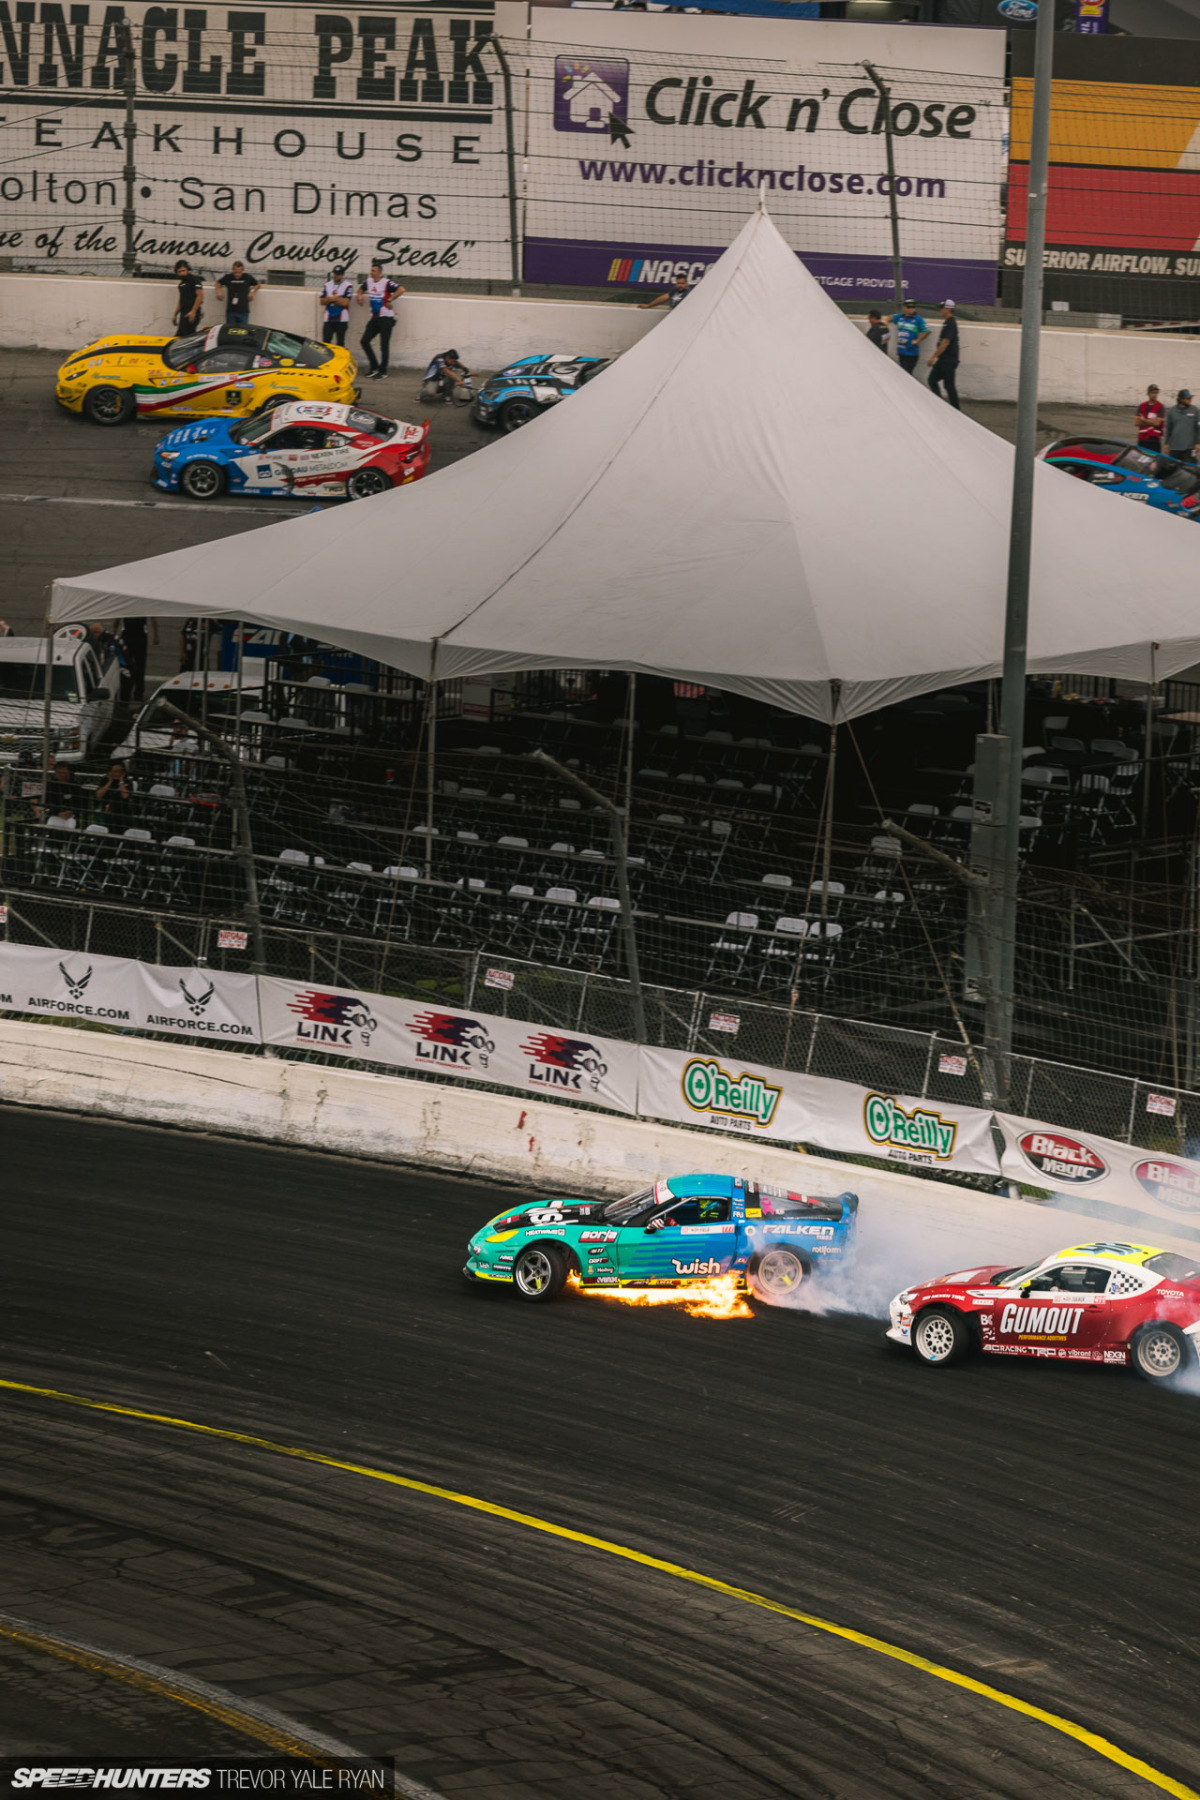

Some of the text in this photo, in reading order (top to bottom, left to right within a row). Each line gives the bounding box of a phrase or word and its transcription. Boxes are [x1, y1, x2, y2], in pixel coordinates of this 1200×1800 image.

[1005, 2, 1034, 18] Ford
[313, 14, 494, 104] PEAK
[646, 75, 769, 129] Click
[839, 87, 976, 139] Close
[0, 117, 481, 165] EAKHOUSE
[579, 159, 946, 198] www.clicknclose.com
[179, 177, 266, 214] San
[293, 181, 438, 220] Dimas
[35, 226, 64, 258] of
[73, 226, 118, 252] the
[246, 231, 360, 267] Cowboy
[638, 259, 716, 285] NASC
[1004, 248, 1091, 271] SUERIOR
[855, 277, 909, 289] PROVIDR
[28, 997, 130, 1020] AIRFORCE.COM
[146, 1014, 253, 1036] AIRFORCE.COM
[296, 1021, 353, 1045] LINK
[415, 1041, 472, 1066] LINK
[528, 1063, 582, 1089] LINK
[686, 1065, 776, 1119] O'Reilly
[709, 1115, 752, 1132] AUTO PARTS
[868, 1098, 952, 1155] O'Reilly
[1030, 1133, 1096, 1166] Black
[1040, 1157, 1098, 1180] Magic
[762, 1224, 835, 1236] FALKEN
[671, 1257, 721, 1275] wish
[1156, 1288, 1185, 1297] TOYOTA
[1000, 1303, 1085, 1334] GUMOUT
